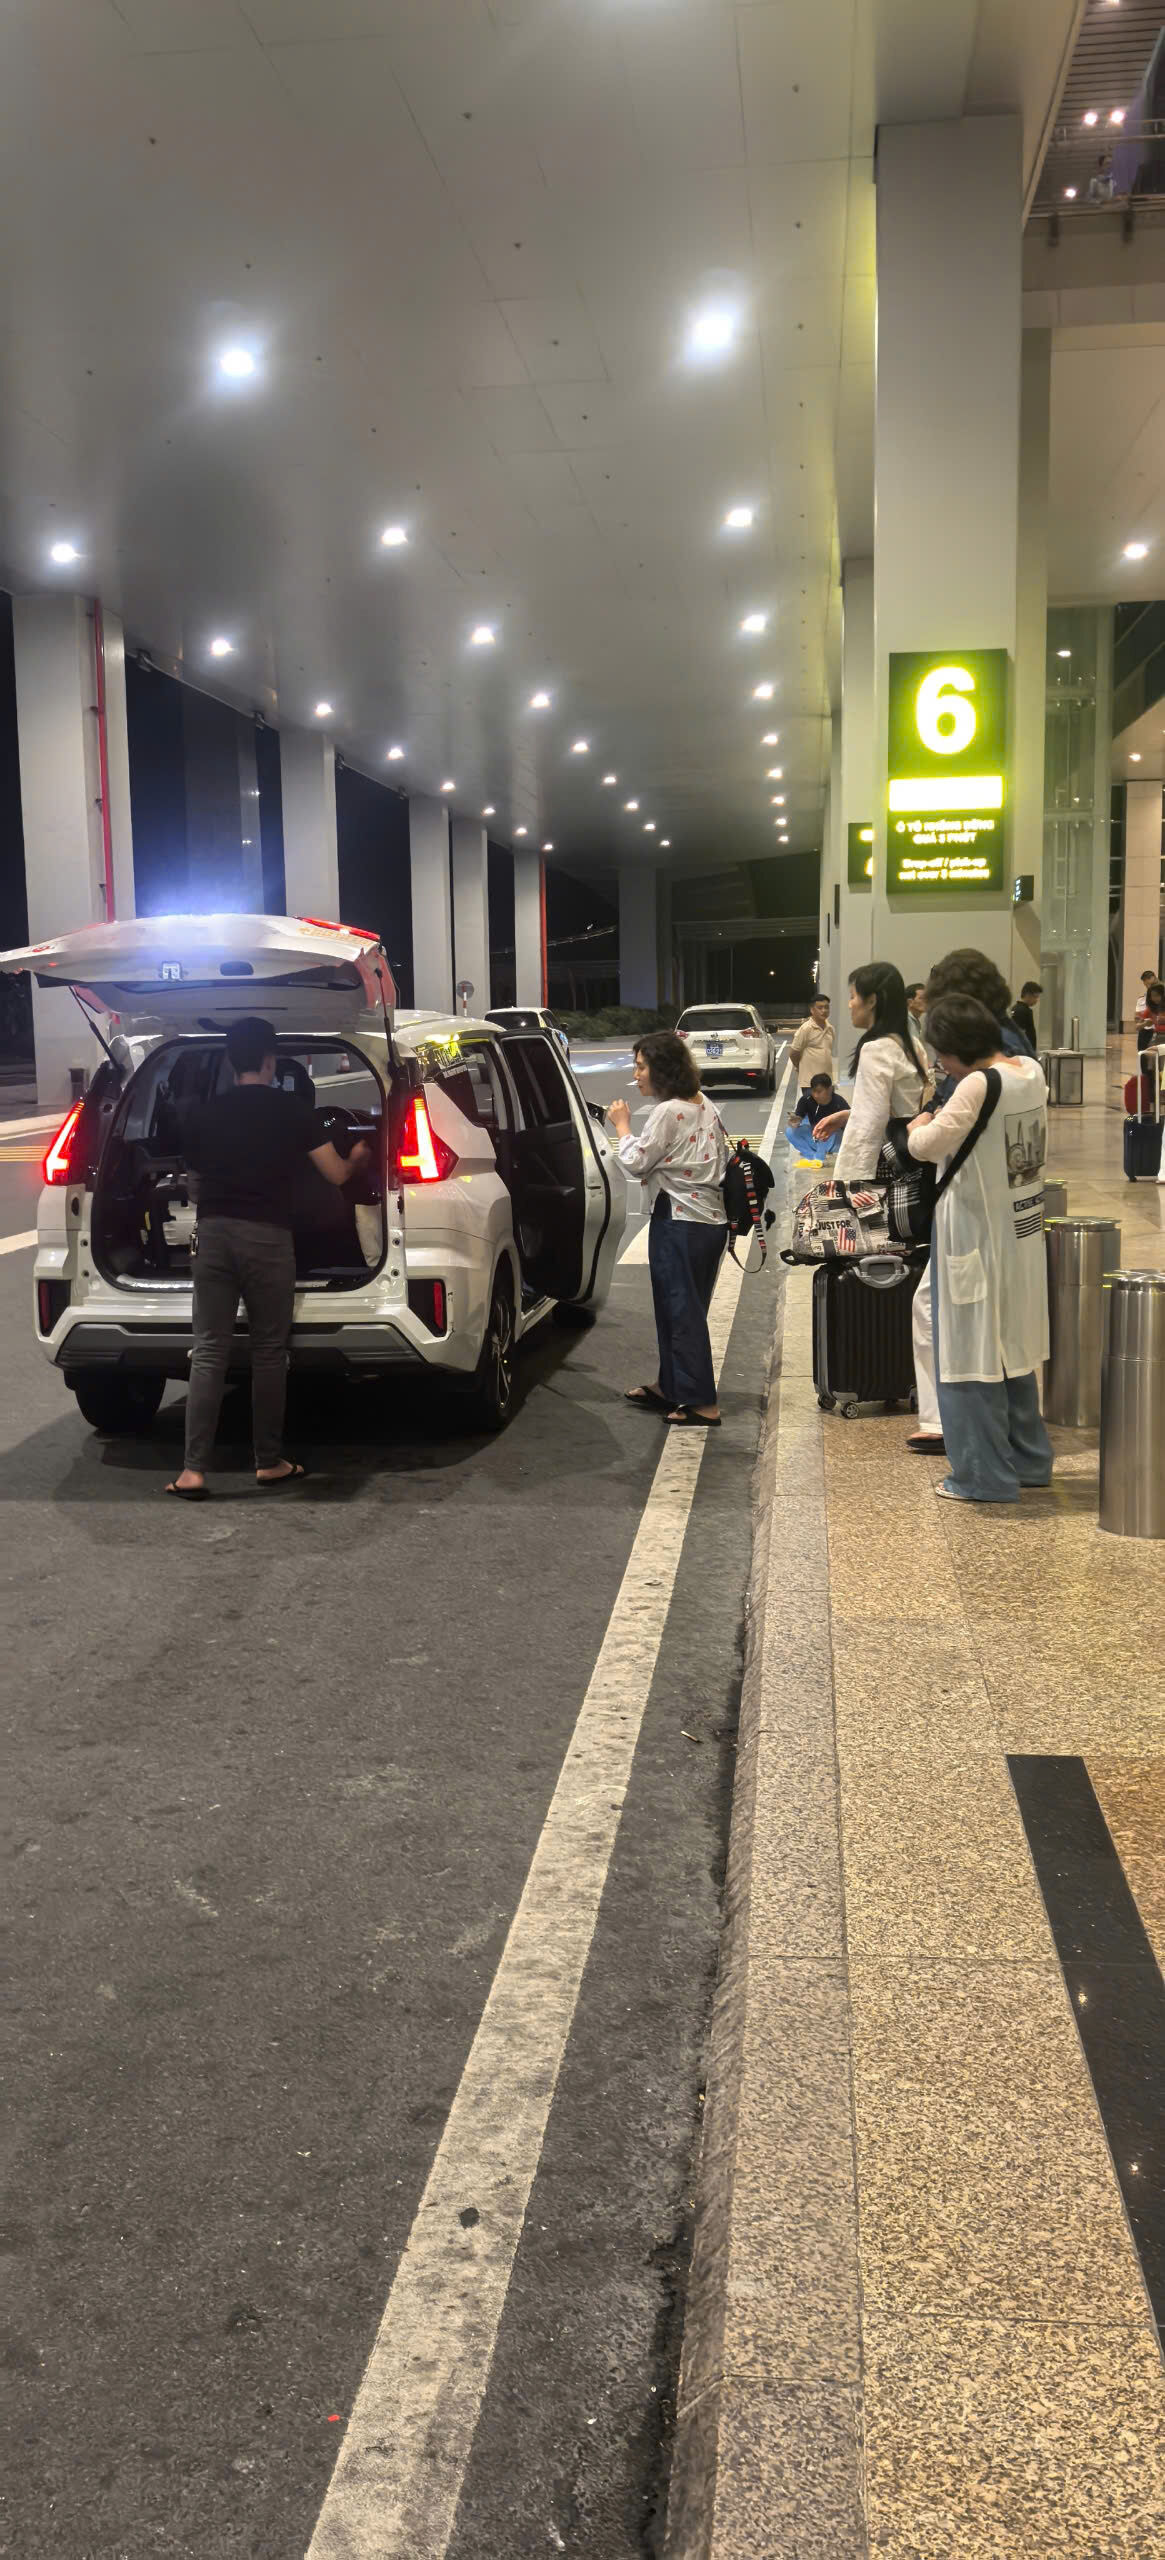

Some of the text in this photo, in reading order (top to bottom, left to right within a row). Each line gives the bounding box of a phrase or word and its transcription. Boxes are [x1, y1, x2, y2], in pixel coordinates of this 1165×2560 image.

[915, 665, 977, 755] 6
[818, 1219, 852, 1231] JUST FOR
